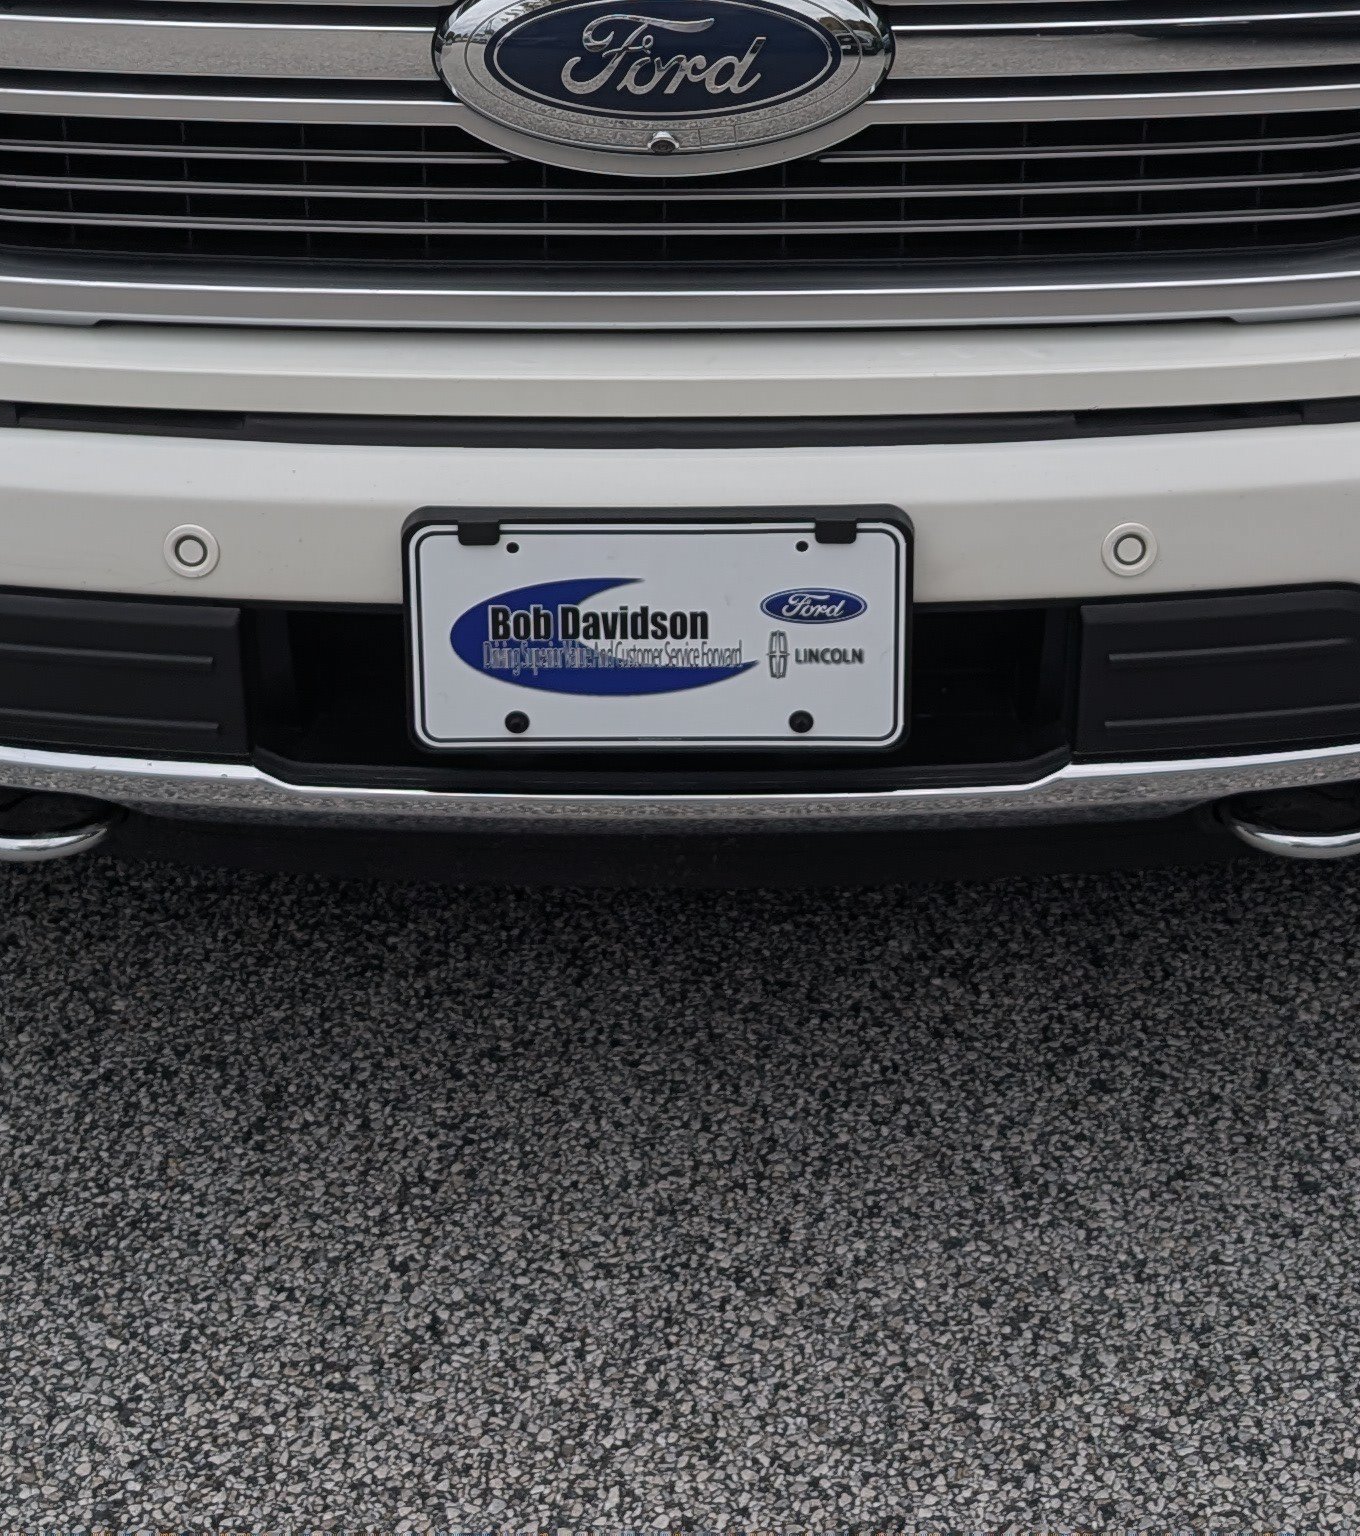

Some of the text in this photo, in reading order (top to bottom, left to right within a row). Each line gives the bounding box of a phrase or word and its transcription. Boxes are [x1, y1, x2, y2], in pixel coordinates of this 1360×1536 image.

[561, 15, 763, 96] Ford
[781, 593, 845, 619] Ford
[491, 605, 709, 641] Bob Davidson
[614, 641, 664, 668] Customer
[665, 641, 700, 668] Service
[701, 640, 743, 668] Forward
[794, 647, 864, 665] LINCOLN
